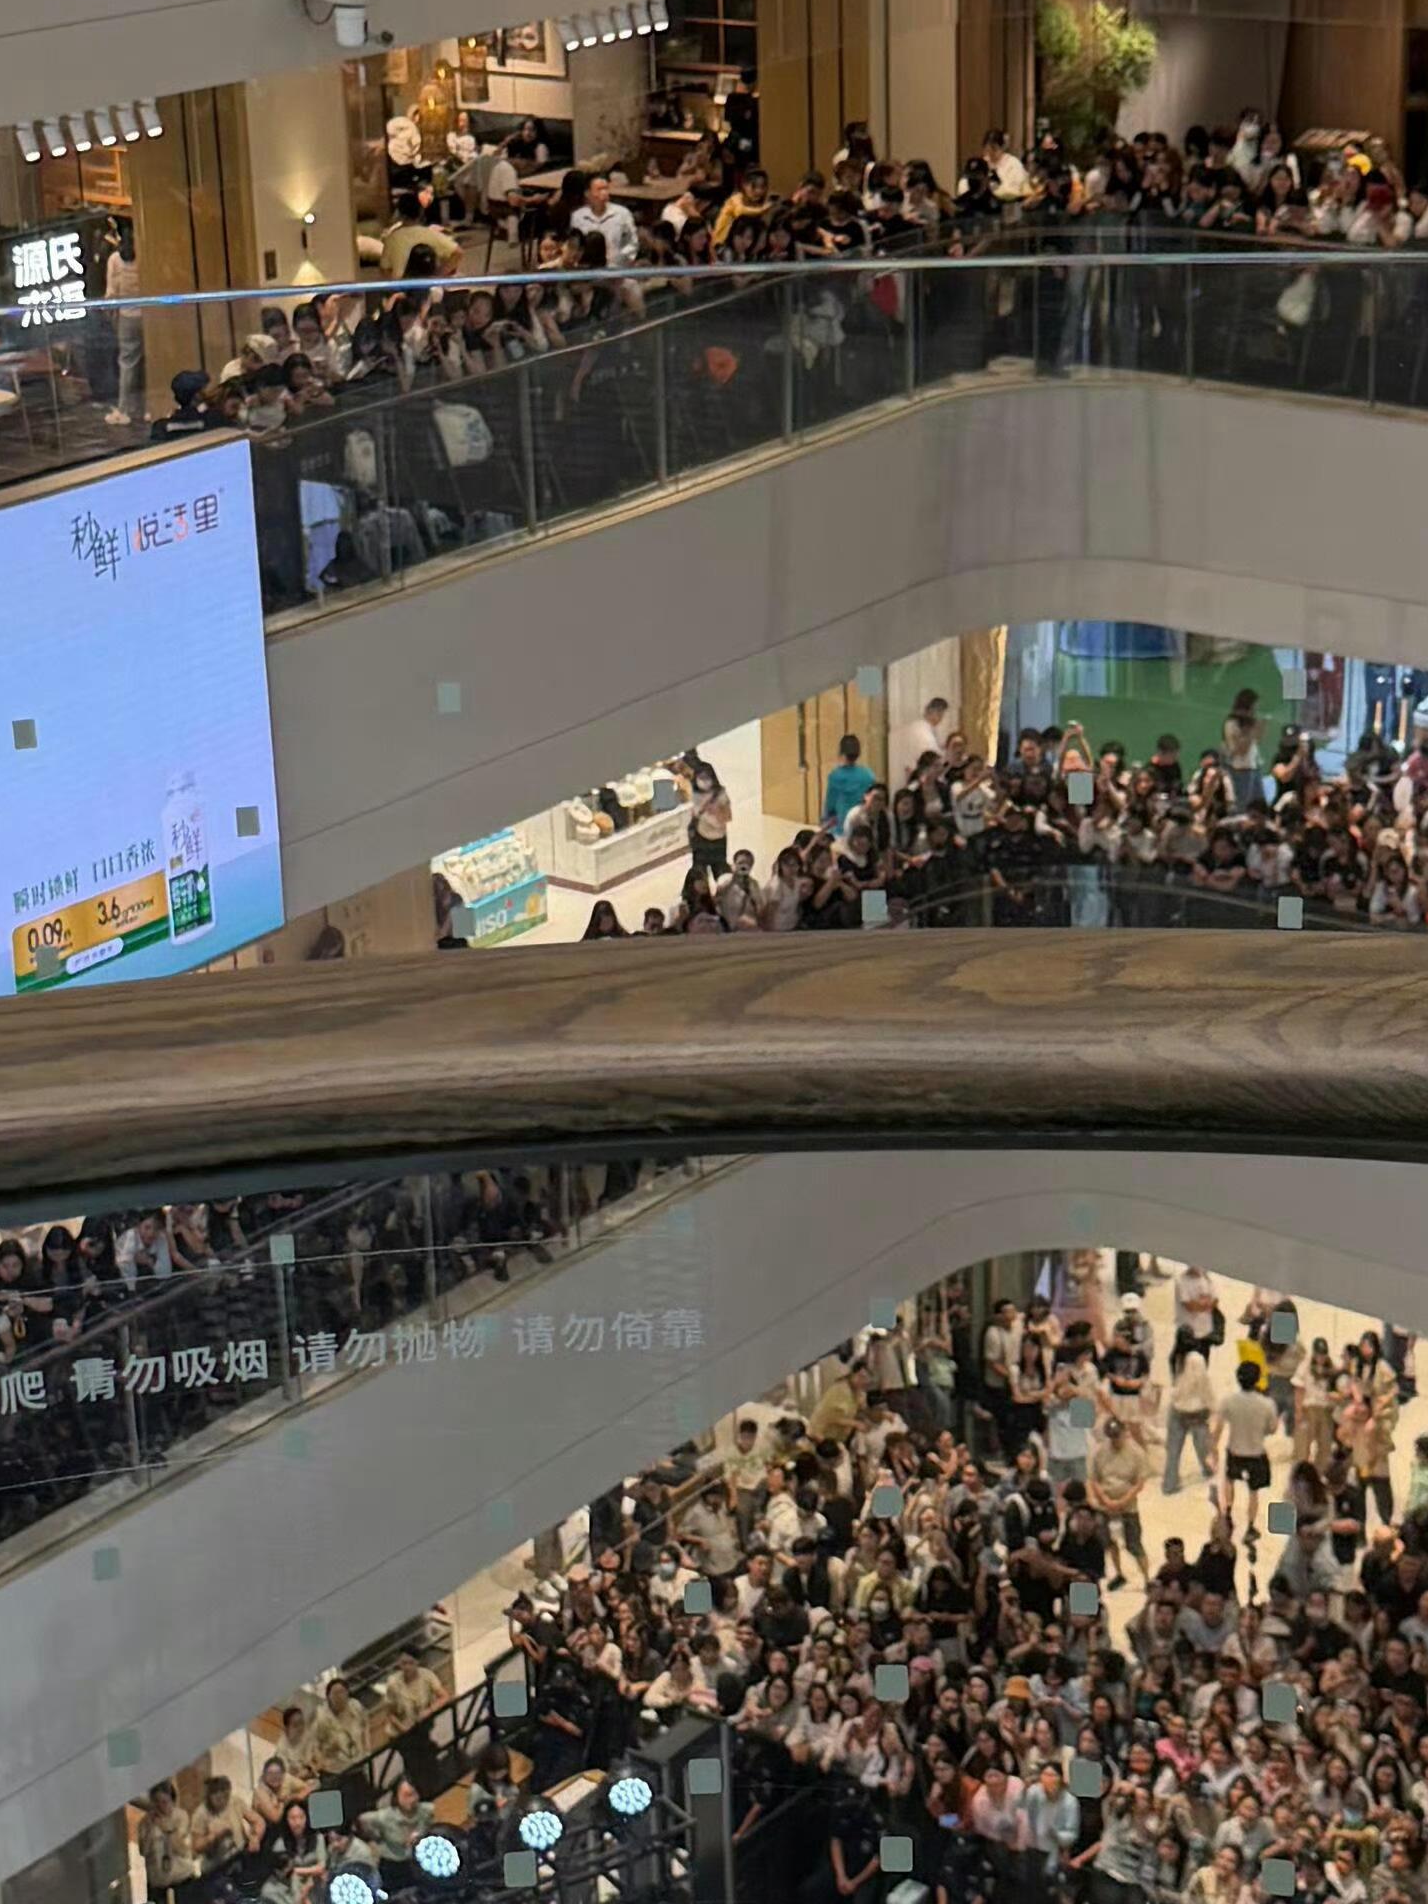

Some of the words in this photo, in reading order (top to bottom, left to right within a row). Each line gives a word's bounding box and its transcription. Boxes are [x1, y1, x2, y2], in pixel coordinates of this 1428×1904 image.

[12, 233, 84, 288] 源氏
[72, 511, 122, 581] 秒鲜
[71, 1336, 269, 1403] 请勿吸烟
[291, 1318, 485, 1376] 请勿抛物
[512, 1307, 706, 1356] 请勿倚靠
